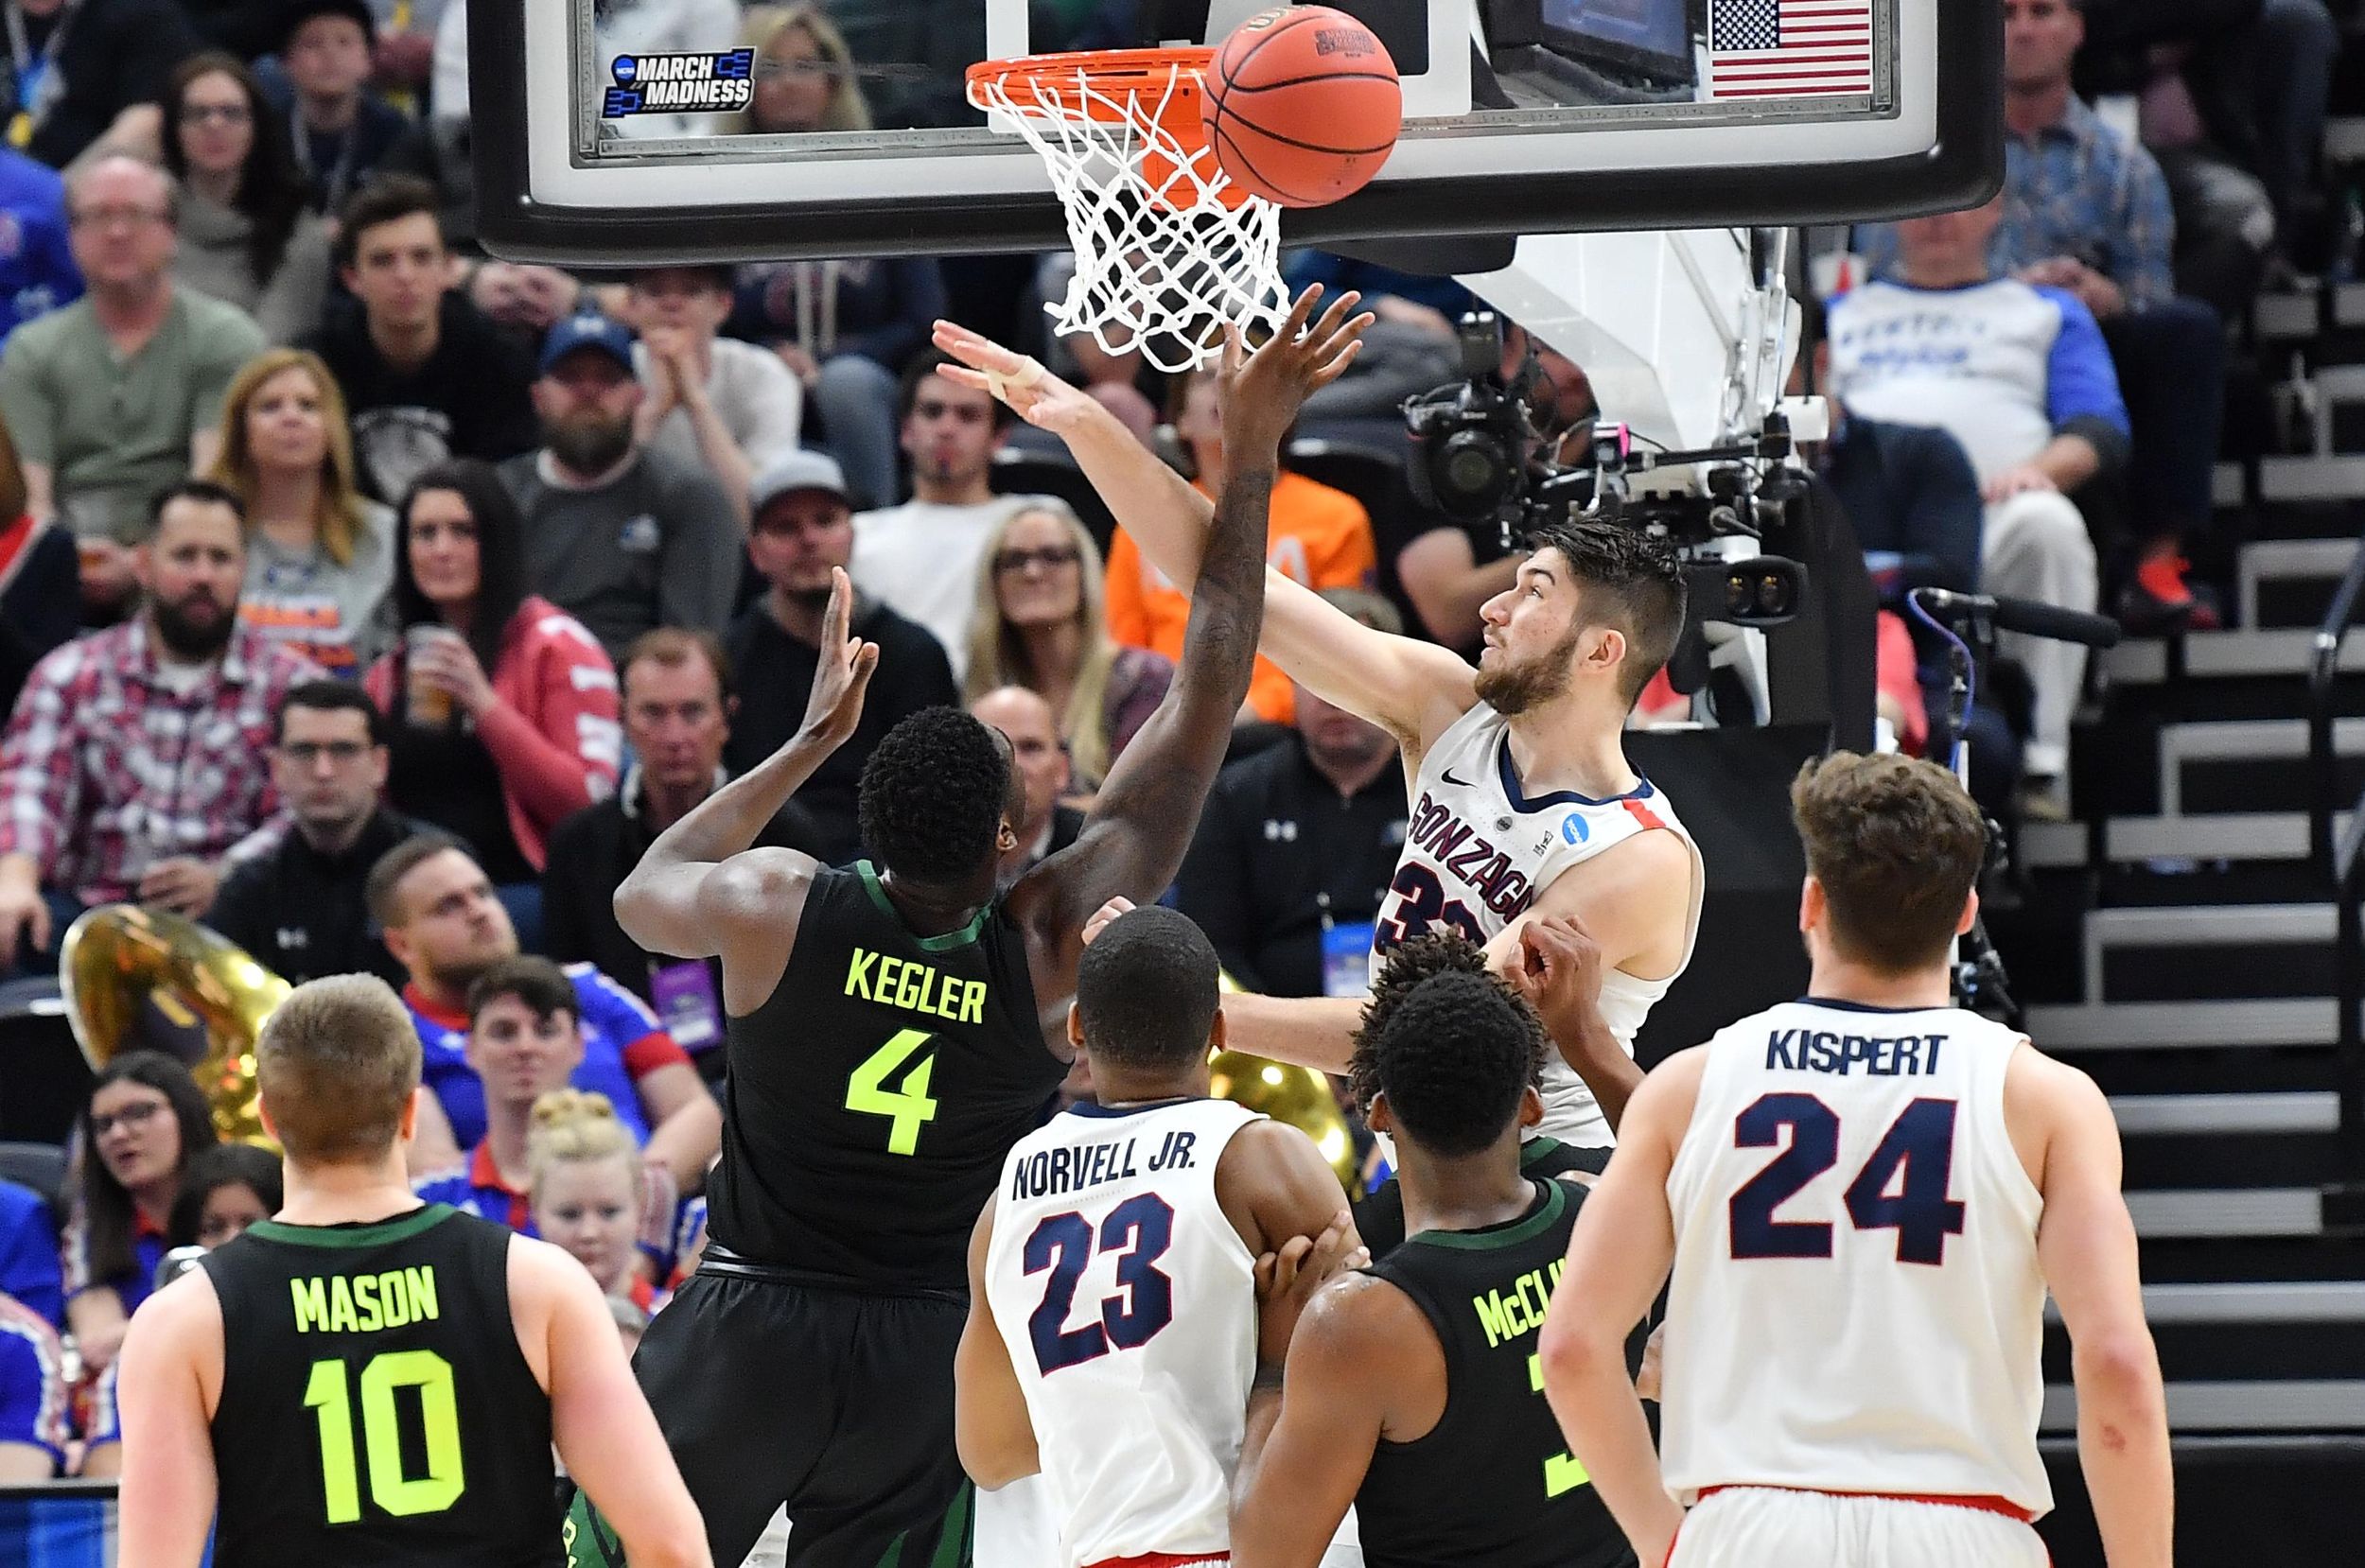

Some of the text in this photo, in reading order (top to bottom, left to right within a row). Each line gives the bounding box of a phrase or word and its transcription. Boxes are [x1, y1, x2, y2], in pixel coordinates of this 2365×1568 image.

[636, 57, 713, 81] MARCH
[644, 78, 751, 105] MADNESS
[845, 948, 987, 1023] KEGLER
[1765, 1029, 1949, 1075] KISPERT
[845, 1028, 937, 1156] 4
[1012, 1131, 1197, 1201] NORVELL JR.
[1729, 1092, 1965, 1265] 24
[290, 1265, 439, 1333] MASON
[1022, 1191, 1175, 1378] 23
[303, 1350, 465, 1524] 10
